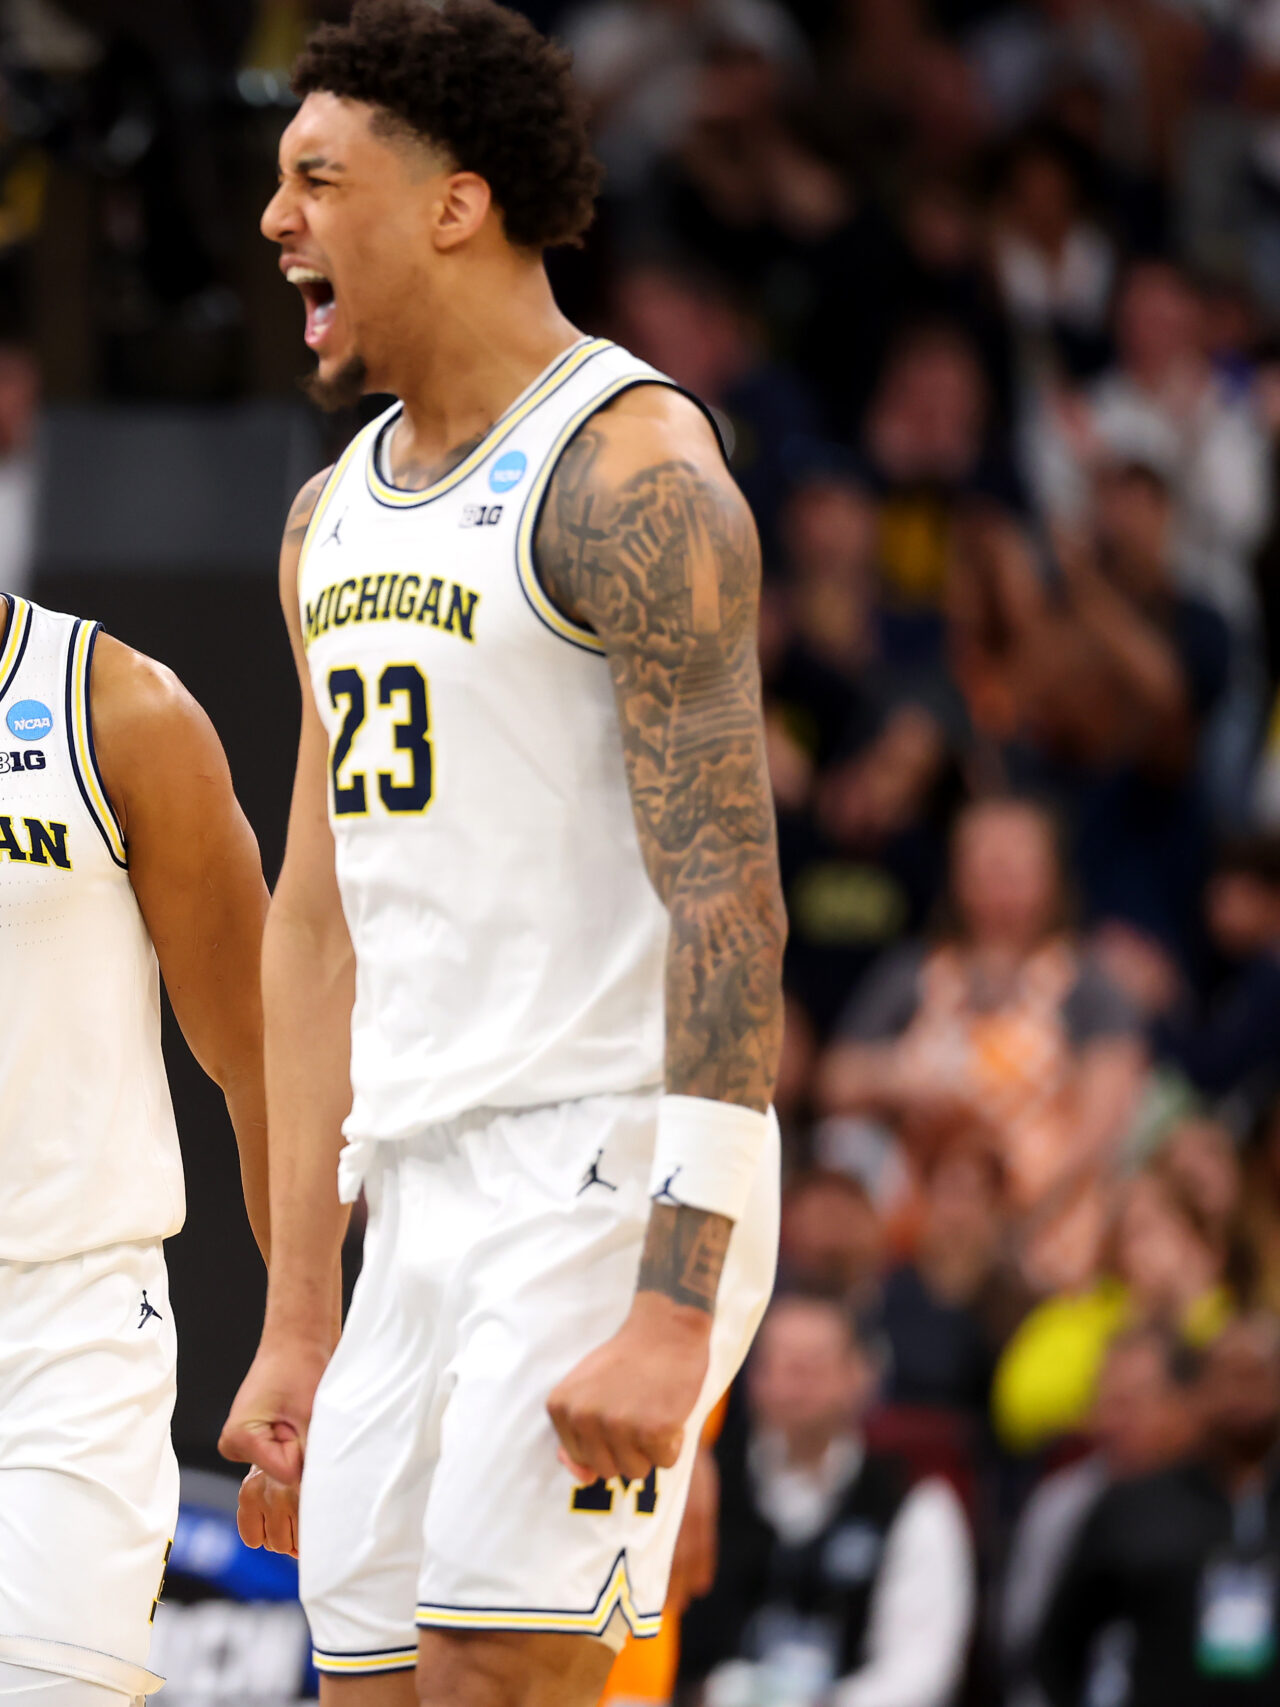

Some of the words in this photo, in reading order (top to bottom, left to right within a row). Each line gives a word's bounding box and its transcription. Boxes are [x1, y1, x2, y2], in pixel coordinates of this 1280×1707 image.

[304, 573, 480, 656] MICHIGAN
[13, 716, 51, 732] NCAA
[327, 662, 436, 820] 23
